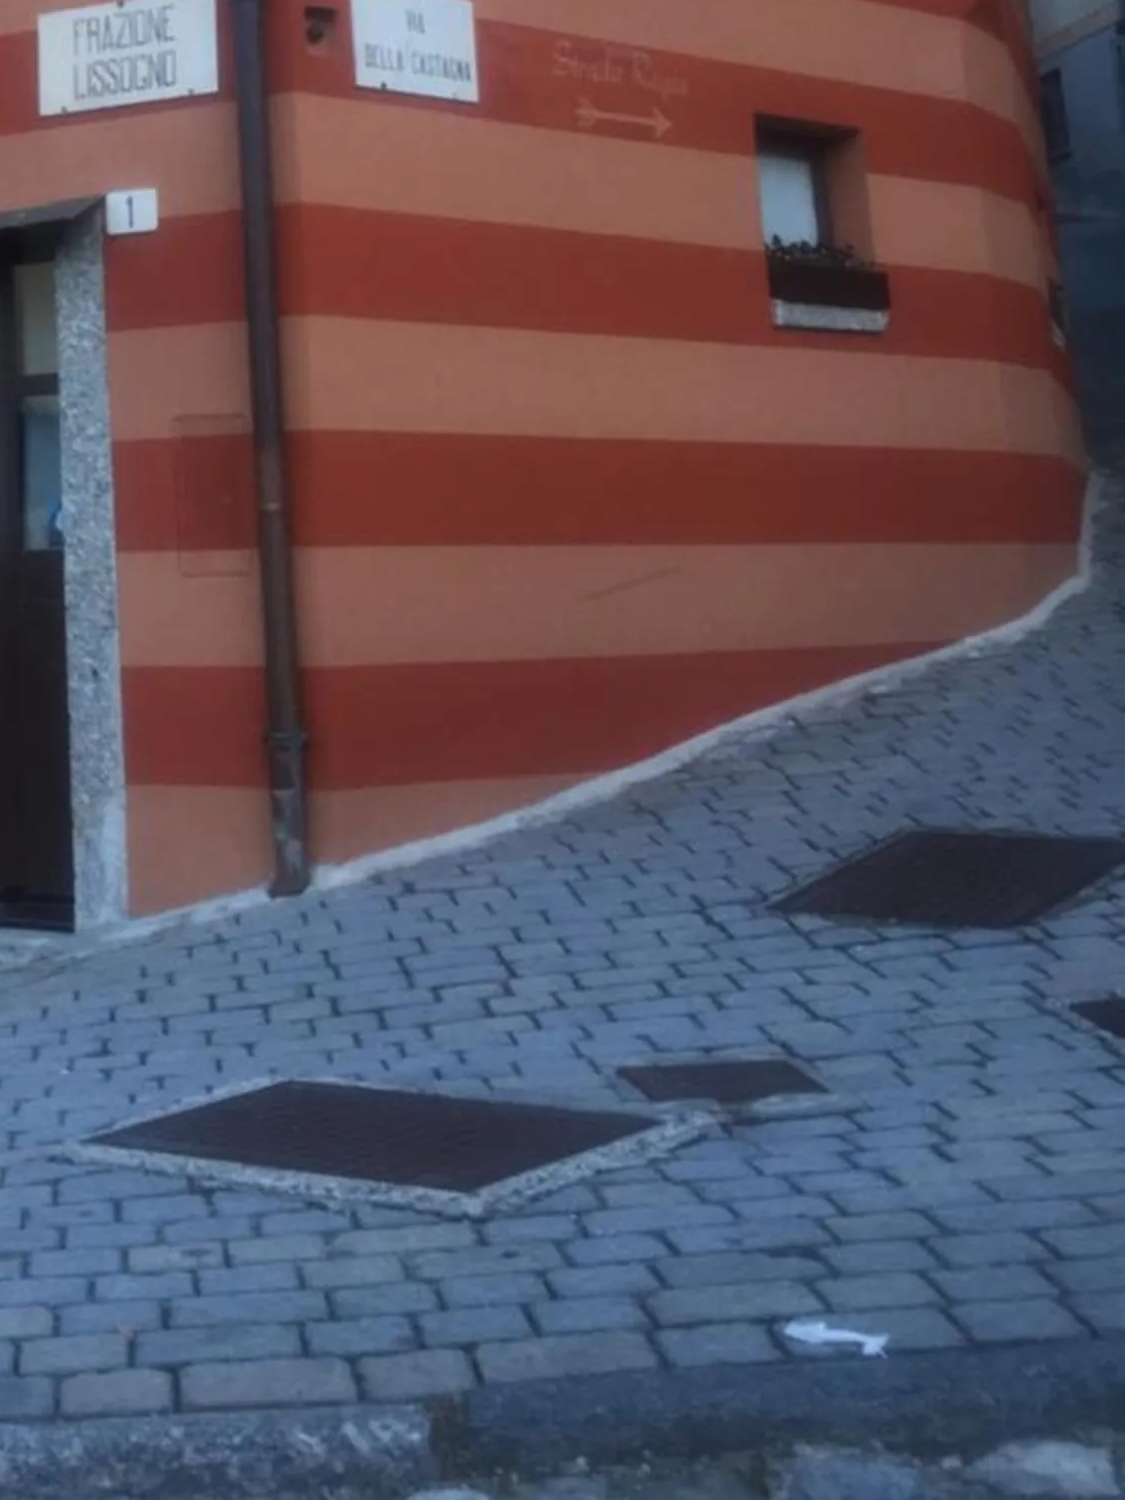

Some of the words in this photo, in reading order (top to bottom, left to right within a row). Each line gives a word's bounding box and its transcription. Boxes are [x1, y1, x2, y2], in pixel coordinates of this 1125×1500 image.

[72, 2, 178, 56] FRAZIONE
[404, 8, 426, 34] VIA
[72, 49, 178, 99] LISSOGNO
[364, 43, 405, 72] DELLA
[411, 49, 472, 82] CASTAGNA
[125, 195, 134, 229] 1
